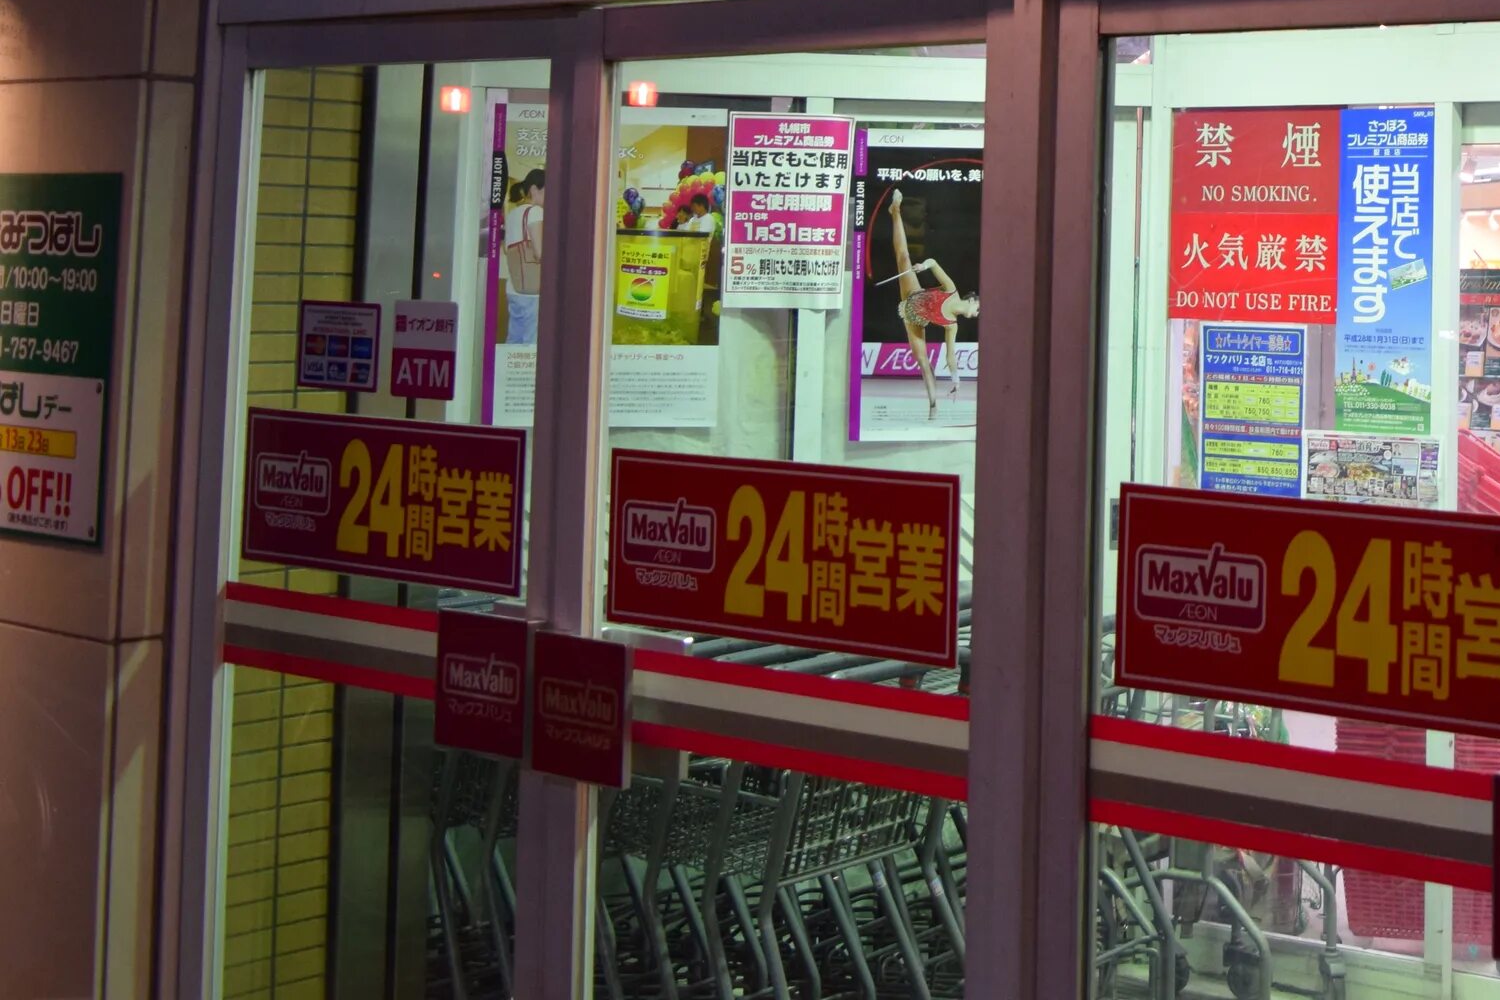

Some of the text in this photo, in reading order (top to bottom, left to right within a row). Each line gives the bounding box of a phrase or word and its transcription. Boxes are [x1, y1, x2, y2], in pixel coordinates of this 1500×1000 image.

[778, 122, 811, 135] 札幌市
[1368, 119, 1408, 132] さっぽろ
[753, 134, 835, 148] プレミアム商品券
[1194, 122, 1322, 169] 禁煙
[1347, 132, 1429, 147] プレミアム商品券
[495, 157, 503, 176] HOT
[732, 150, 849, 170] 当店でもご使用
[735, 171, 845, 189] いただけます
[876, 167, 984, 182] 平和への願いを、美
[491, 177, 502, 204] PRESS
[750, 193, 833, 212] ご使用期限
[856, 181, 865, 198] HOT
[1201, 184, 1318, 203] NO SMOKING.
[734, 212, 769, 221] 2016年
[855, 200, 865, 227] PRESS
[1391, 163, 1420, 260] 当店で
[744, 222, 837, 243] 1月31日まで
[1352, 163, 1391, 324] 使えます
[1180, 232, 1329, 273] 火気厳禁
[1, 301, 40, 327] 日曜日
[1176, 290, 1338, 312] DO NOT USE FIRE.
[408, 317, 455, 334] イオン銀行
[396, 357, 450, 388] ATM
[263, 451, 324, 493] MaxValu
[7, 465, 72, 518] OFF!!
[336, 438, 513, 561] 24時間営業
[630, 499, 707, 548] MaxValu
[724, 484, 946, 627] 24時間営業
[635, 567, 698, 591] マックスバリュ
[1147, 544, 1253, 600] MaxValu
[1154, 623, 1242, 654] マックスバリュ
[449, 653, 514, 695] MaxValu
[545, 680, 613, 722] MaxValu
